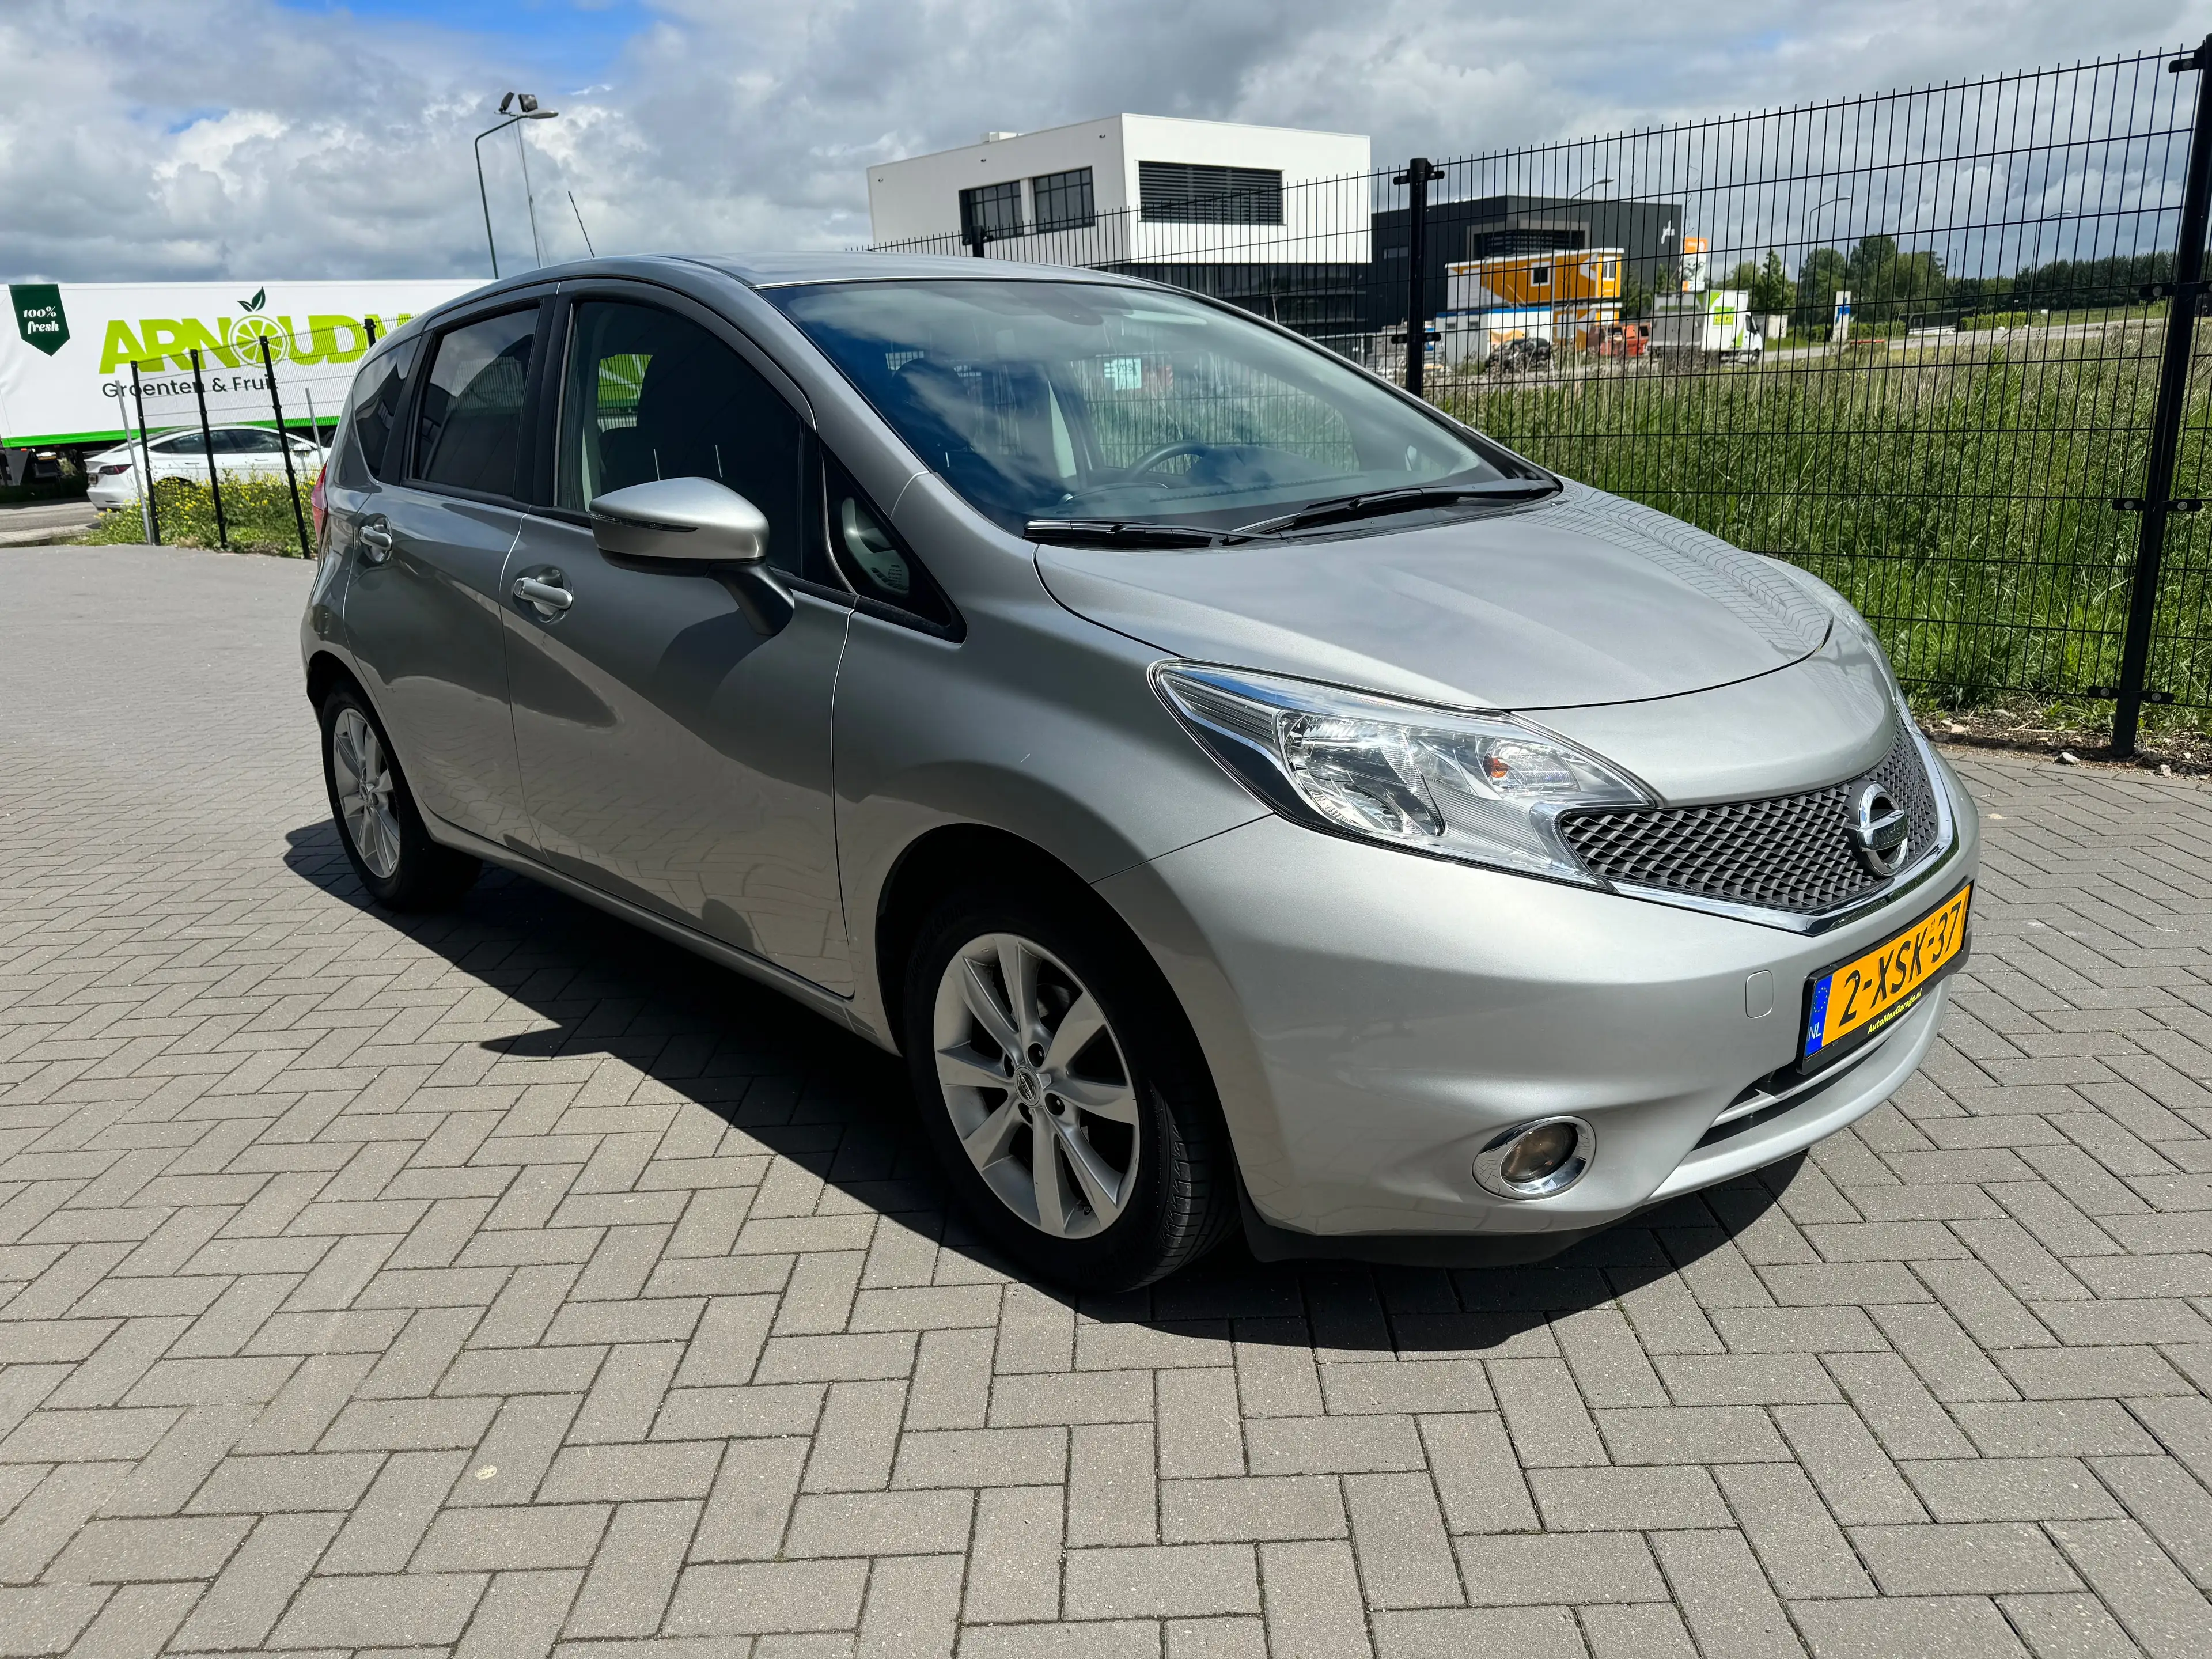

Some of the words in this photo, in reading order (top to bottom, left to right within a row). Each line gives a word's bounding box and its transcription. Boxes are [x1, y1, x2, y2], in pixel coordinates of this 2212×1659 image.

[23, 305, 56, 318] 100%
[27, 320, 59, 335] fresh
[212, 377, 229, 392] &
[233, 374, 279, 392] Frui
[1838, 899, 1962, 1028] 2-XSK-37
[1867, 988, 1922, 1035] AutoMaxGarage.nl
[1808, 1023, 1822, 1042] NL
